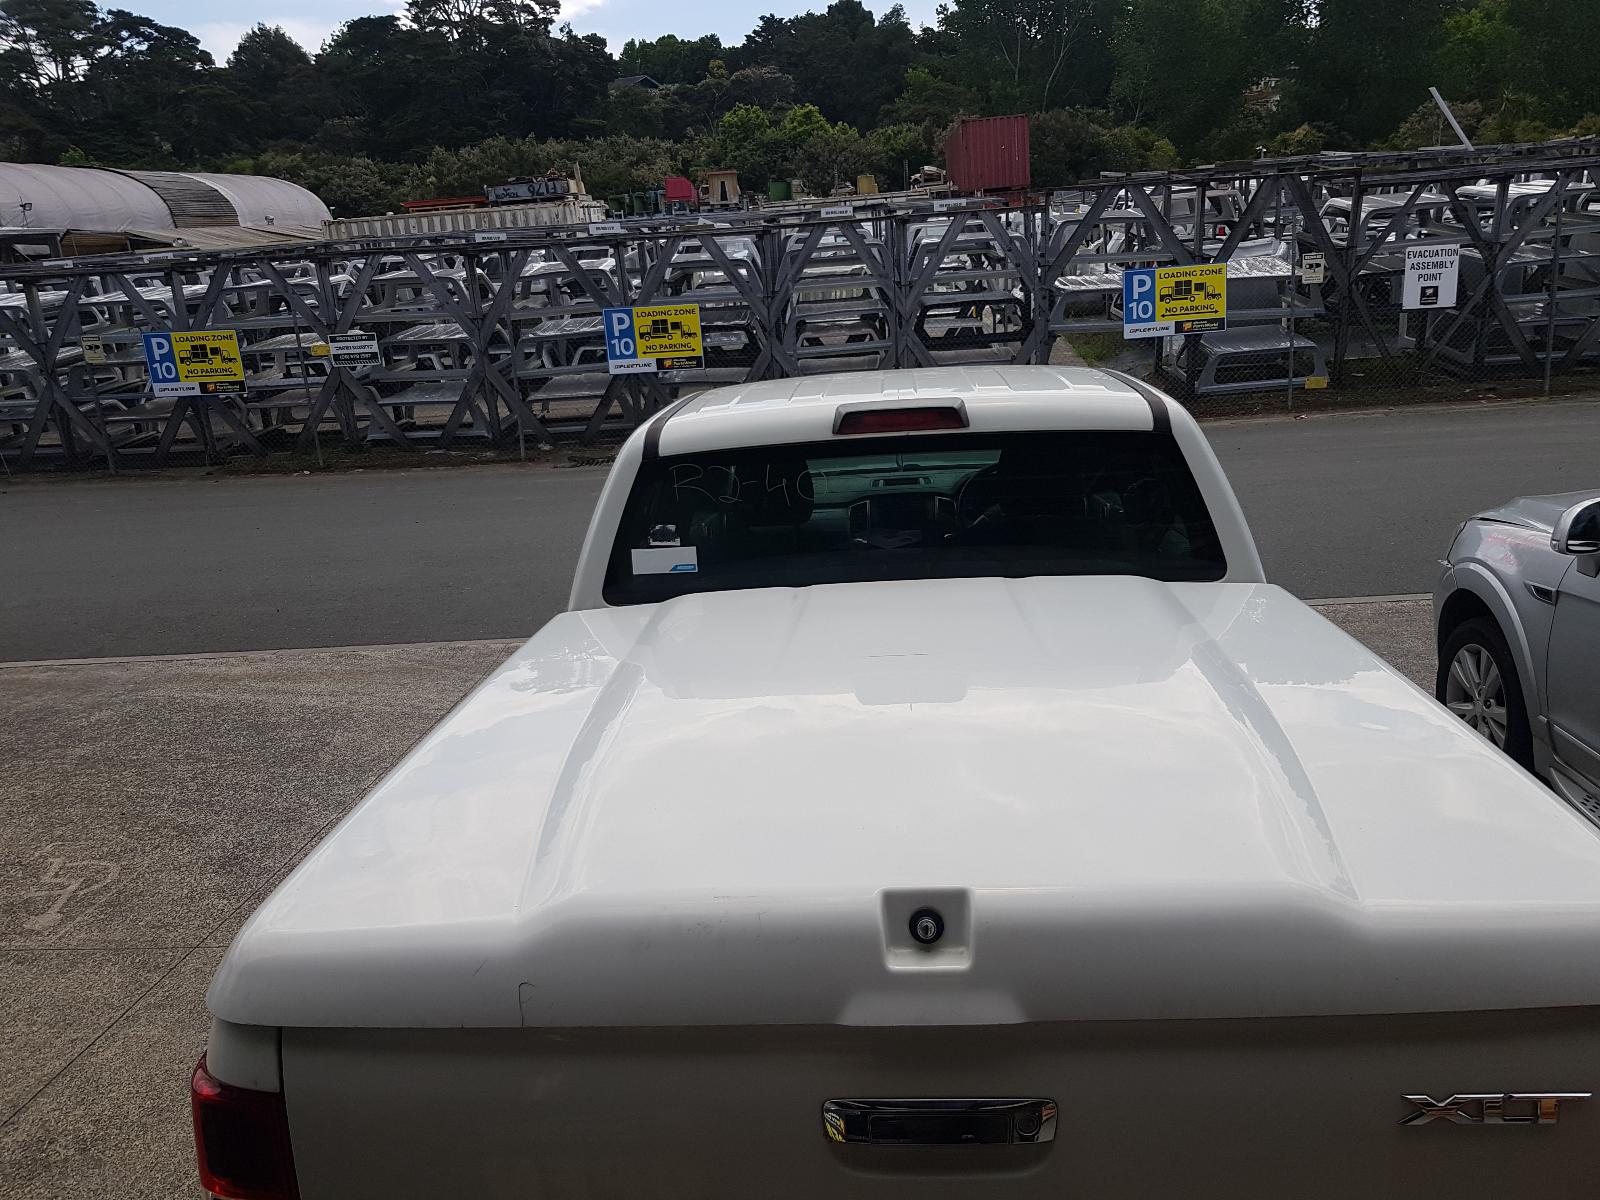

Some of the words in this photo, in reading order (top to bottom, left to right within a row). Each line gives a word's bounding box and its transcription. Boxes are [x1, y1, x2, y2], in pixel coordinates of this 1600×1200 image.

[1407, 248, 1459, 259] EVACUATION
[1410, 260, 1455, 270] ASSEMBLY
[1160, 270, 1198, 280] LOADING
[1200, 268, 1223, 276] ZONE
[1418, 272, 1443, 282] POINT
[1132, 274, 1152, 300] P
[636, 310, 673, 318] LOADING
[1128, 300, 1152, 320] 10
[1180, 304, 1215, 312] PARKING
[612, 312, 630, 336] P
[150, 338, 170, 360] P
[611, 338, 634, 356] 10
[152, 362, 176, 379] 10
[1398, 1093, 1592, 1125] XLT
